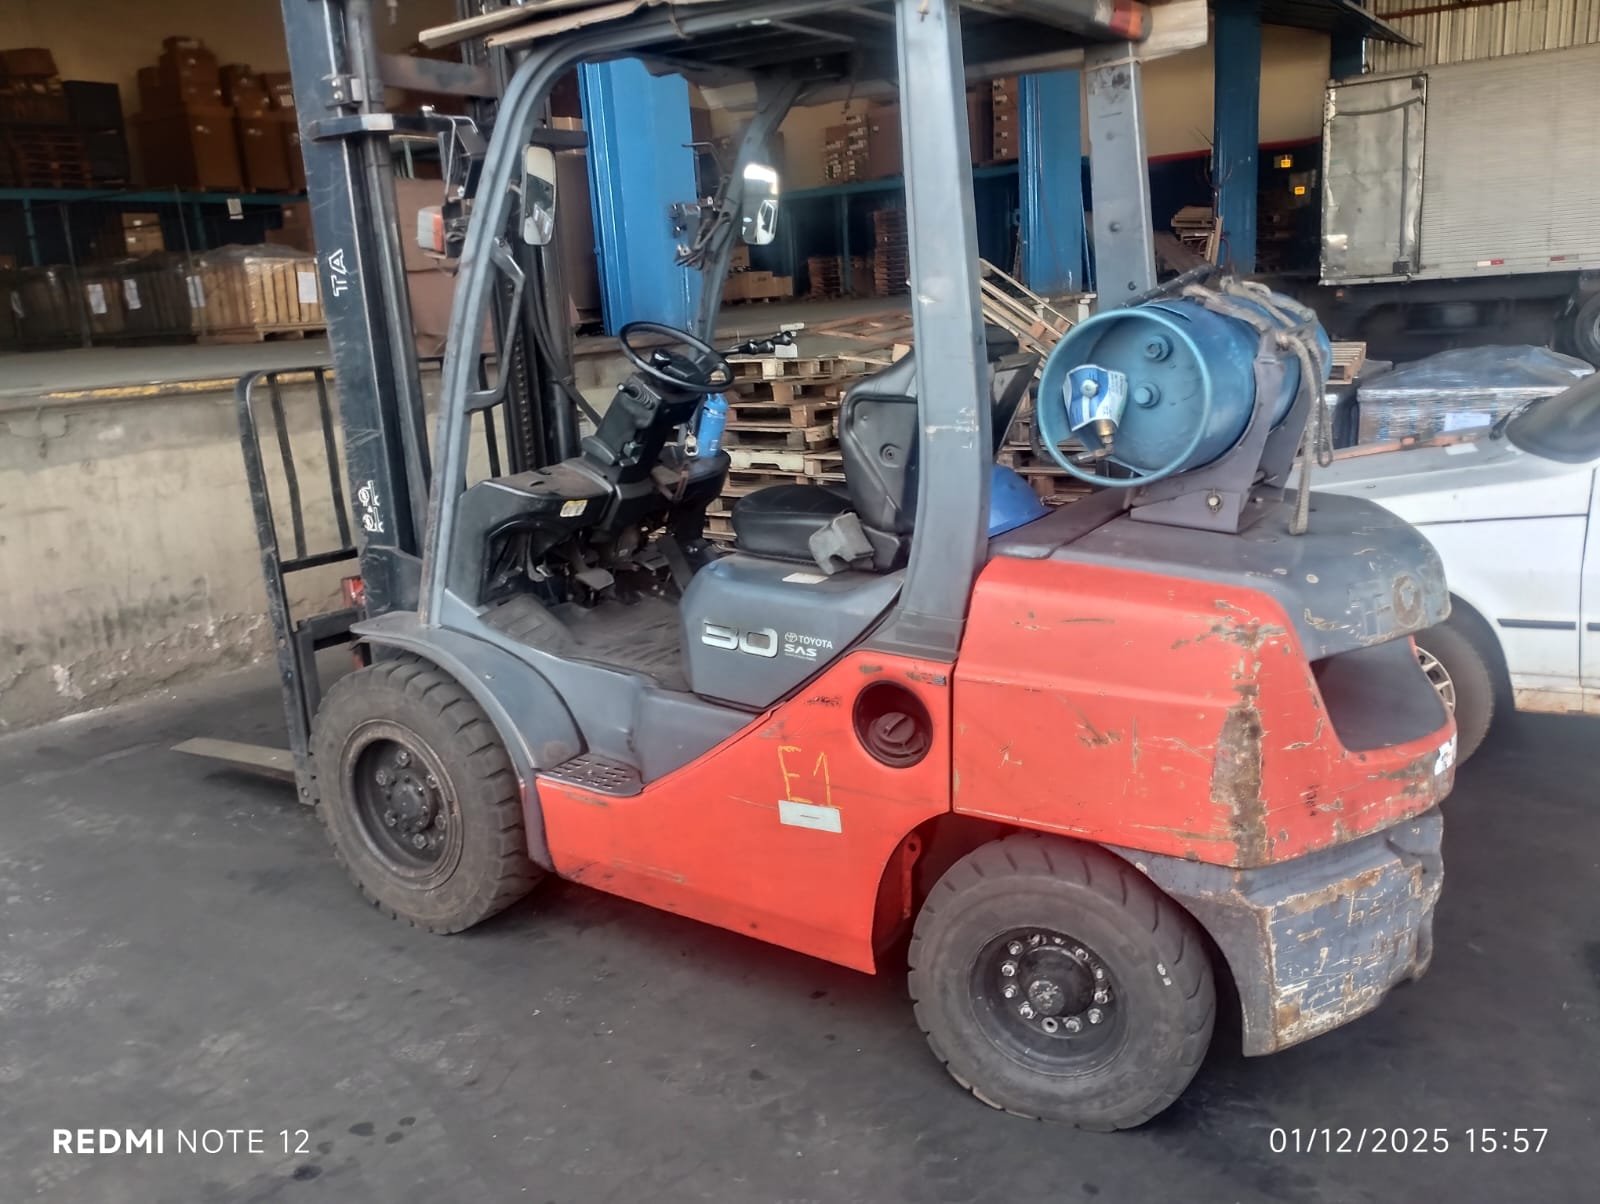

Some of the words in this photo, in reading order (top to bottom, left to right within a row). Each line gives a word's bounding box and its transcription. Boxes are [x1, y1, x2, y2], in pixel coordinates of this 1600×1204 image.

[701, 618, 778, 658] 30
[798, 635, 833, 649] TOYOTA
[783, 644, 818, 657] SAS
